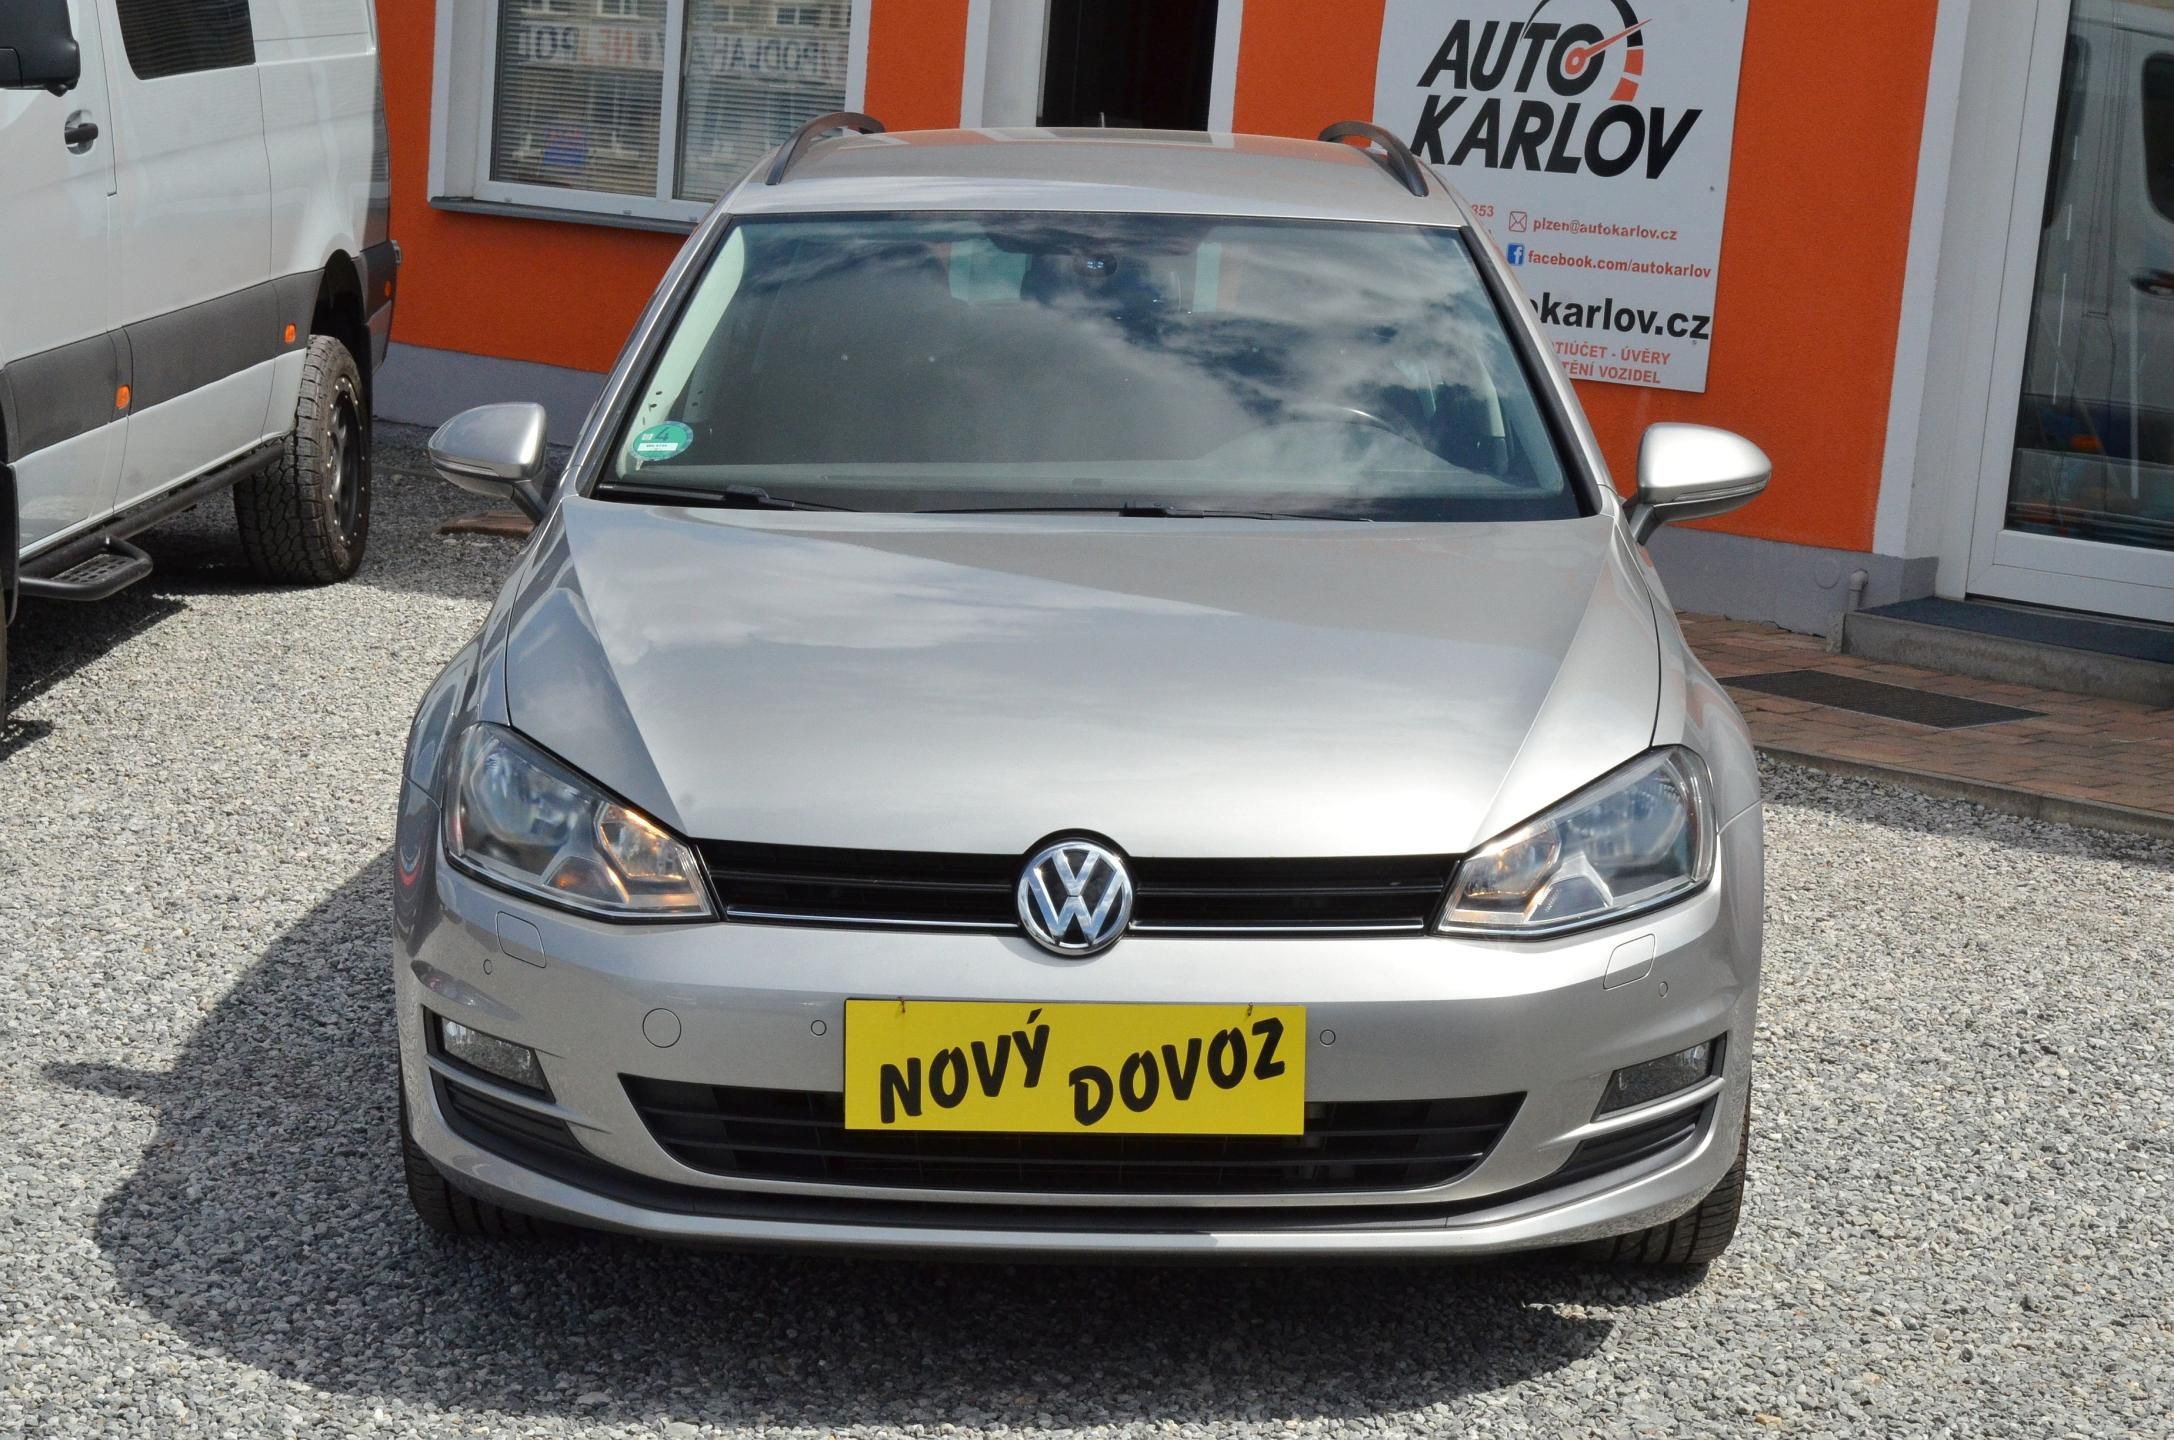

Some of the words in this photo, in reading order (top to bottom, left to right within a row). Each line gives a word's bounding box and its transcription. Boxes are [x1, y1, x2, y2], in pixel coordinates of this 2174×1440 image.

[1416, 19, 1606, 97] AUTO
[1409, 94, 1703, 180] KARLOV
[1533, 217, 1679, 241] plzen@autokarlov.cz
[1528, 250, 1712, 278] facebook.com/autokarlov
[1552, 340, 1607, 358] TIÚČET
[1599, 365, 1661, 384] VOZIDEL
[879, 1007, 1050, 1124] NOVÝ
[1068, 1017, 1286, 1127] DOVOZ
